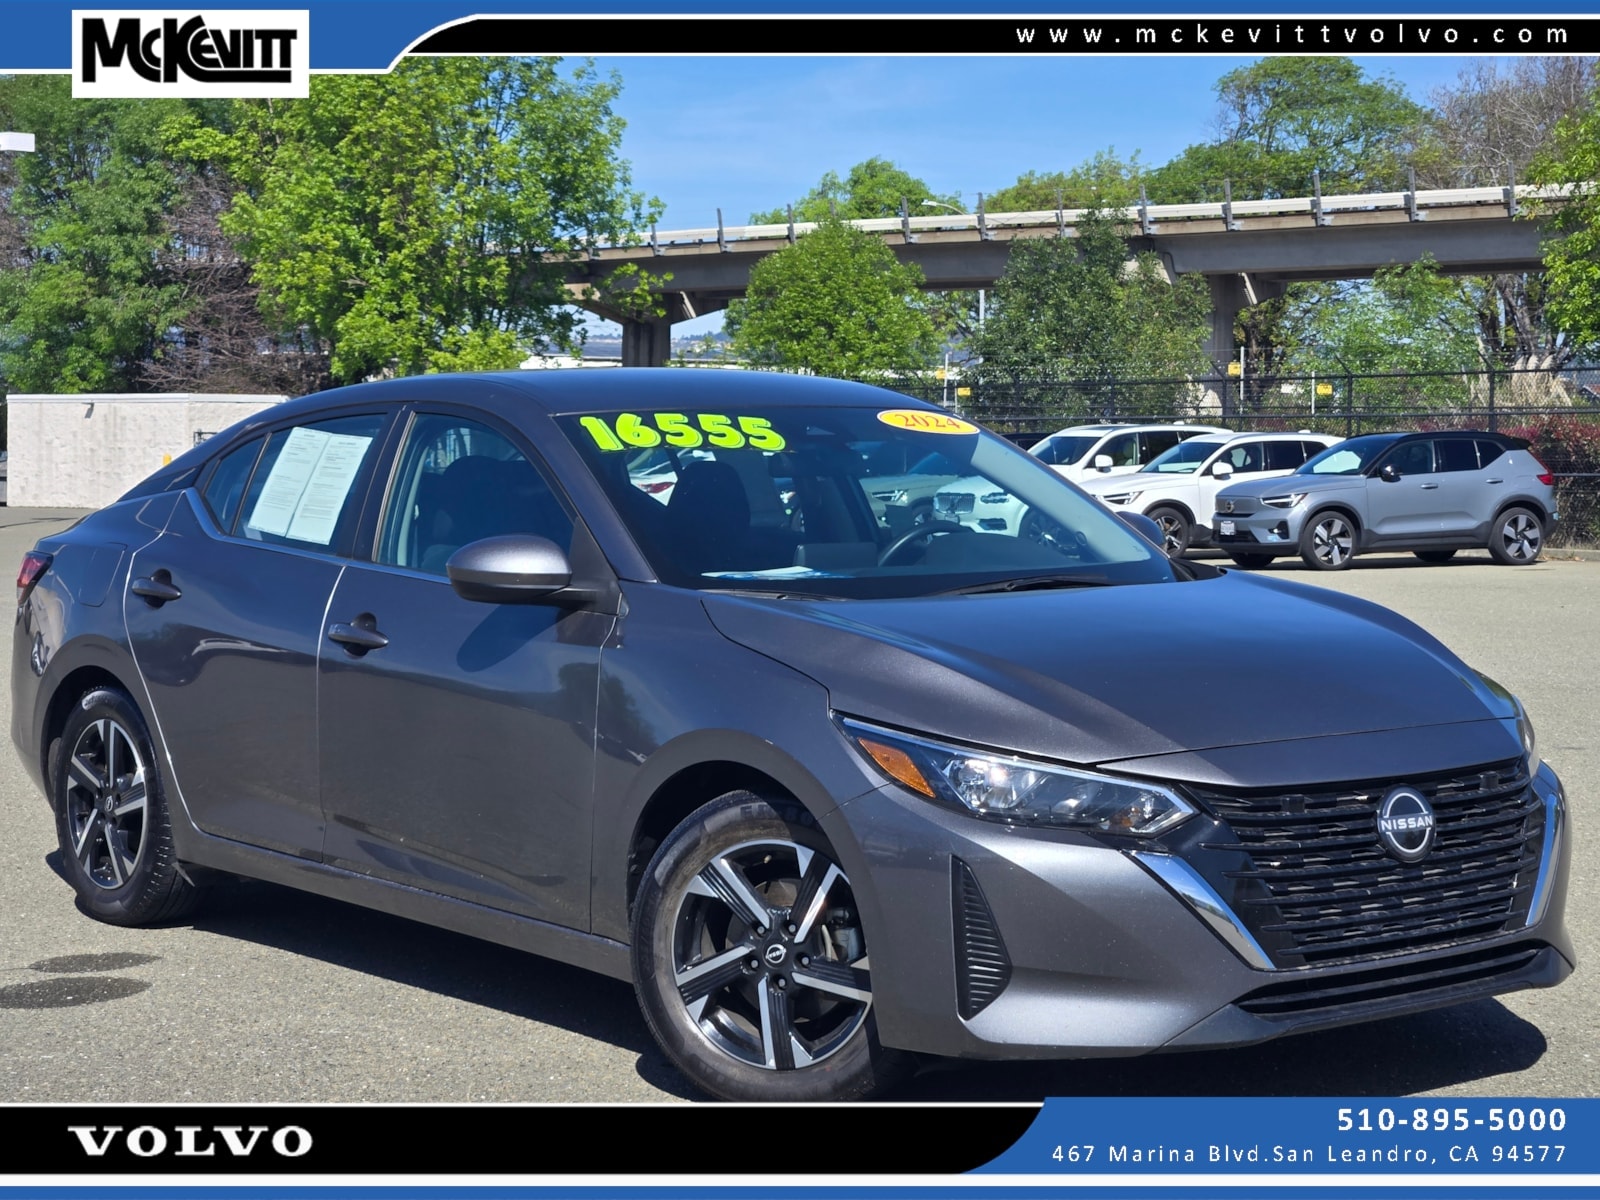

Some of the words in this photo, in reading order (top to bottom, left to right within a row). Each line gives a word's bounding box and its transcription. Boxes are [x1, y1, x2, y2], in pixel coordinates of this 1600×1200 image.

[893, 413, 961, 429] 2024
[580, 413, 786, 451] 16555
[1380, 815, 1433, 831] NISSAN
